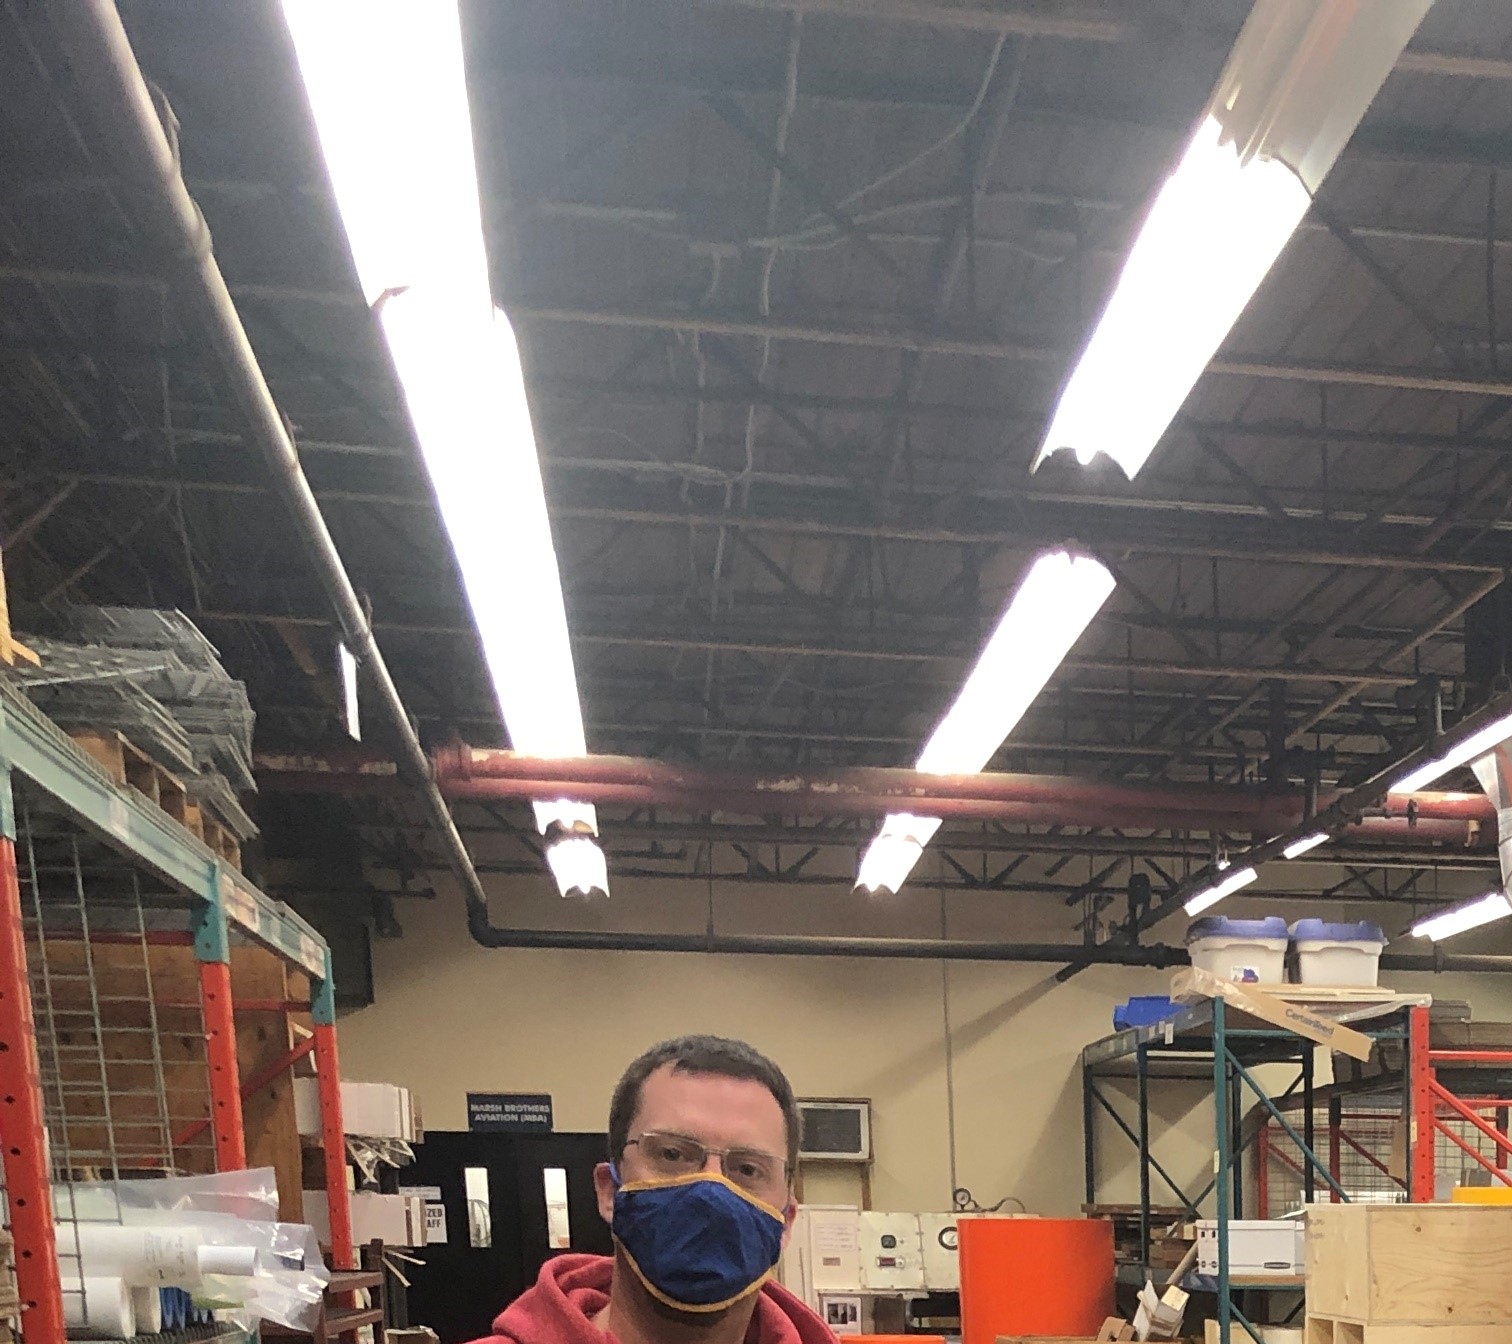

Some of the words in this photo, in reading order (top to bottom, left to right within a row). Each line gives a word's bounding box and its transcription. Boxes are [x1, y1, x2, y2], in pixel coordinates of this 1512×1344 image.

[470, 1103, 502, 1112] MARSH
[504, 1104, 550, 1113] BROTHERS
[474, 1113, 519, 1122] AVIATION
